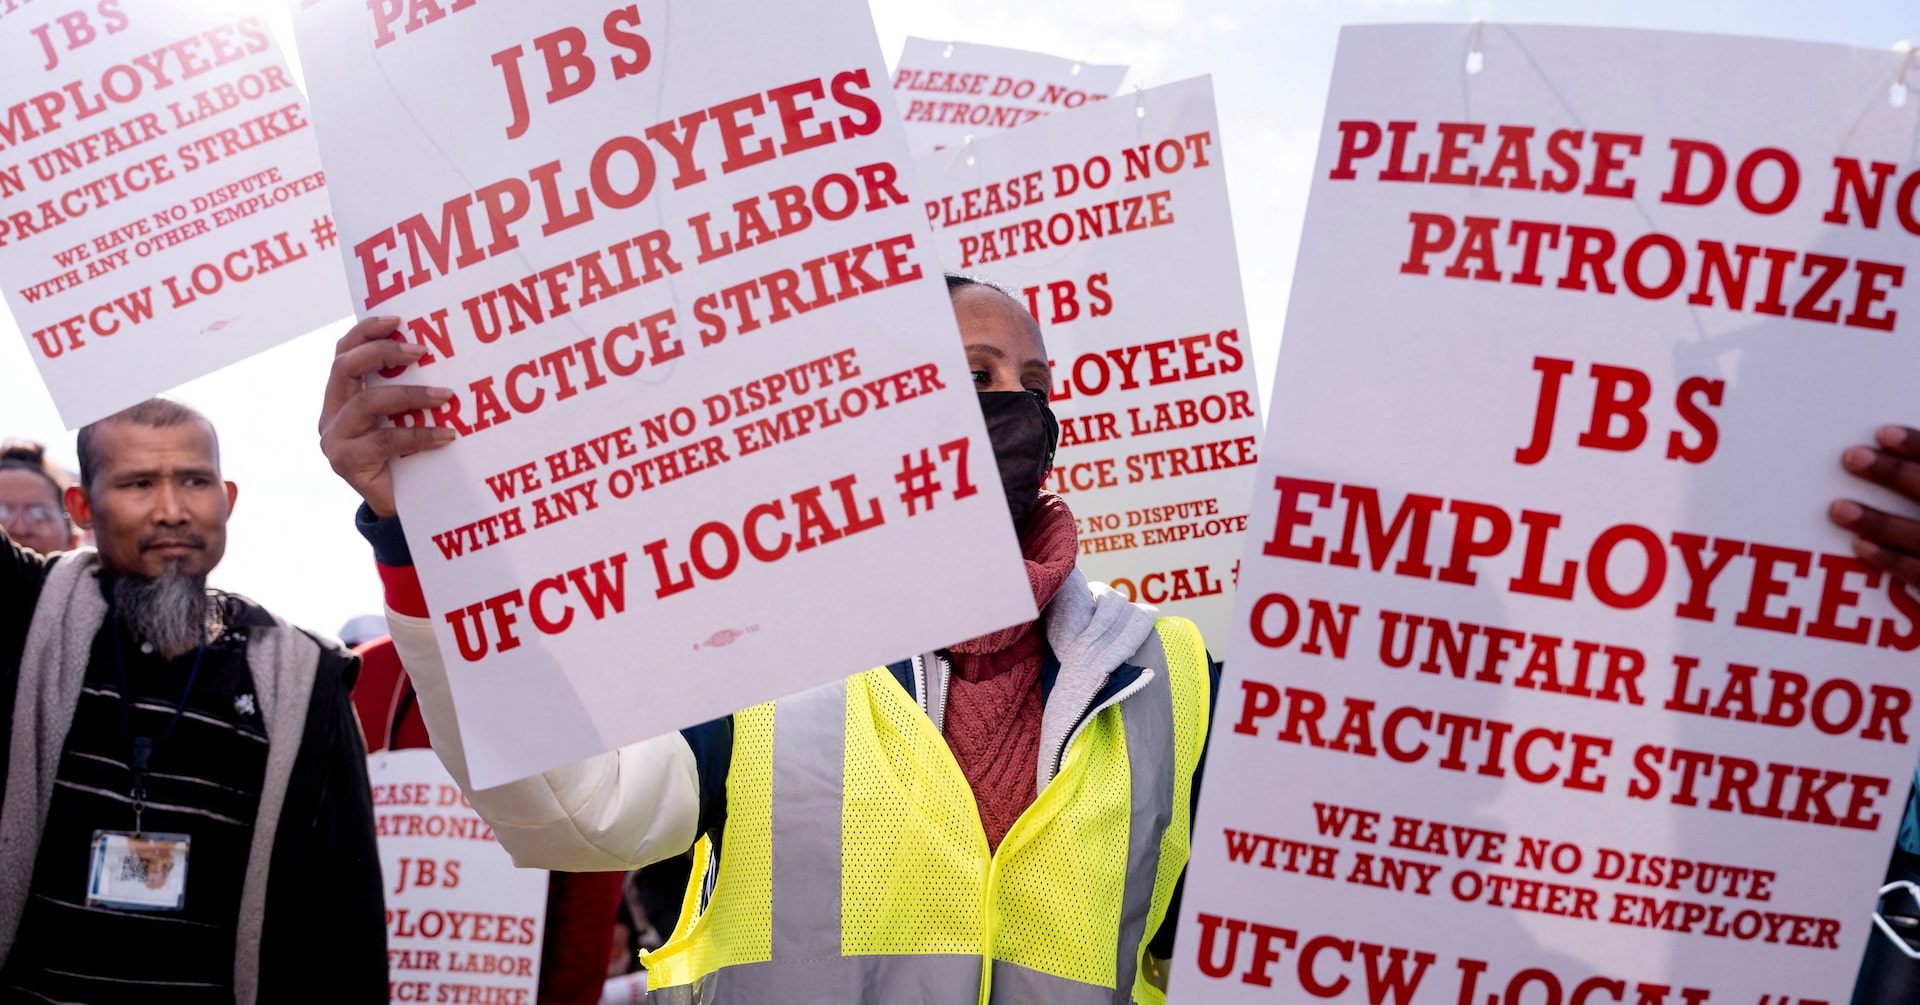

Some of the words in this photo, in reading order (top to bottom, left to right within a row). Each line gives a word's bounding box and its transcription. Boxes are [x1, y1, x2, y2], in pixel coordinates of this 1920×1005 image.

[31, 0, 128, 71] JBS
[492, 5, 651, 139] JBS
[0, 42, 266, 146] MPLOYEES
[0, 165, 25, 198] N
[28, 113, 167, 182] UNFAIR
[167, 66, 292, 129] LABOR
[177, 103, 308, 172] STRIKE
[893, 69, 989, 95] PLEASE
[989, 76, 1036, 99] DO
[1039, 84, 1108, 109] NO
[53, 244, 91, 268] WE
[92, 219, 151, 253] HAVE
[153, 205, 188, 229] NO
[191, 167, 282, 214] DISPUTE
[355, 68, 882, 309] EMPLOYEES
[925, 171, 1044, 231] PLEASE
[1052, 156, 1111, 198] DO
[1122, 132, 1211, 182] NOT
[1329, 121, 1643, 199] PLEASE
[1661, 139, 1800, 215] DO
[20, 270, 82, 303] WITH
[86, 249, 128, 279] ANY
[135, 218, 210, 257] OTHER
[462, 230, 682, 343] UNFAIR
[688, 162, 909, 263] LABOR
[960, 191, 1174, 268] PATRONIZE
[1401, 213, 1904, 331] PATRONIZE
[32, 287, 153, 358] UFCW
[162, 232, 307, 308] LOCAL
[694, 234, 923, 347] STRIKE
[1048, 329, 1243, 402] LOYEES
[1515, 357, 1724, 465] JBS
[432, 507, 526, 560] WITH
[532, 480, 598, 528] ANY
[608, 436, 730, 499] OTHER
[733, 363, 945, 456] EMPLOYER
[485, 462, 541, 502] WE
[545, 427, 637, 483] HAVE
[640, 407, 696, 448] NO
[703, 348, 860, 426] DISPUTE
[1059, 413, 1121, 447] AIR
[1127, 390, 1254, 436] LABOR
[1126, 436, 1258, 483] STRIKE
[445, 553, 627, 661] UFCW
[643, 475, 884, 599] LOCAL
[895, 438, 977, 516] #7
[1079, 533, 1138, 555] THER
[1142, 515, 1248, 546] EMPLOYE
[1088, 514, 1120, 533] NO
[1126, 498, 1219, 527] DISPUTE
[1250, 593, 1360, 659] ON
[1380, 611, 1645, 705] UNFAIR
[1664, 655, 1911, 744] LABOR
[371, 784, 431, 806] EASE
[1234, 680, 1613, 793] PRACTICE
[1627, 744, 1889, 830] STRIKE
[375, 814, 496, 842] ATRONIZ
[394, 858, 460, 894] JBS
[1313, 802, 1380, 843] WE
[1389, 816, 1506, 864] HAVE
[1515, 837, 1582, 874] NO
[1593, 848, 1775, 901] DISPUTE
[1224, 829, 1339, 879] WITH
[1346, 852, 1441, 895] ANY
[1452, 871, 1598, 920] OTHER
[1609, 893, 1840, 949] EMPLOYER
[437, 984, 528, 1005] STRIKE
[448, 952, 532, 977] LABOR
[1197, 913, 1436, 1005] UFCW
